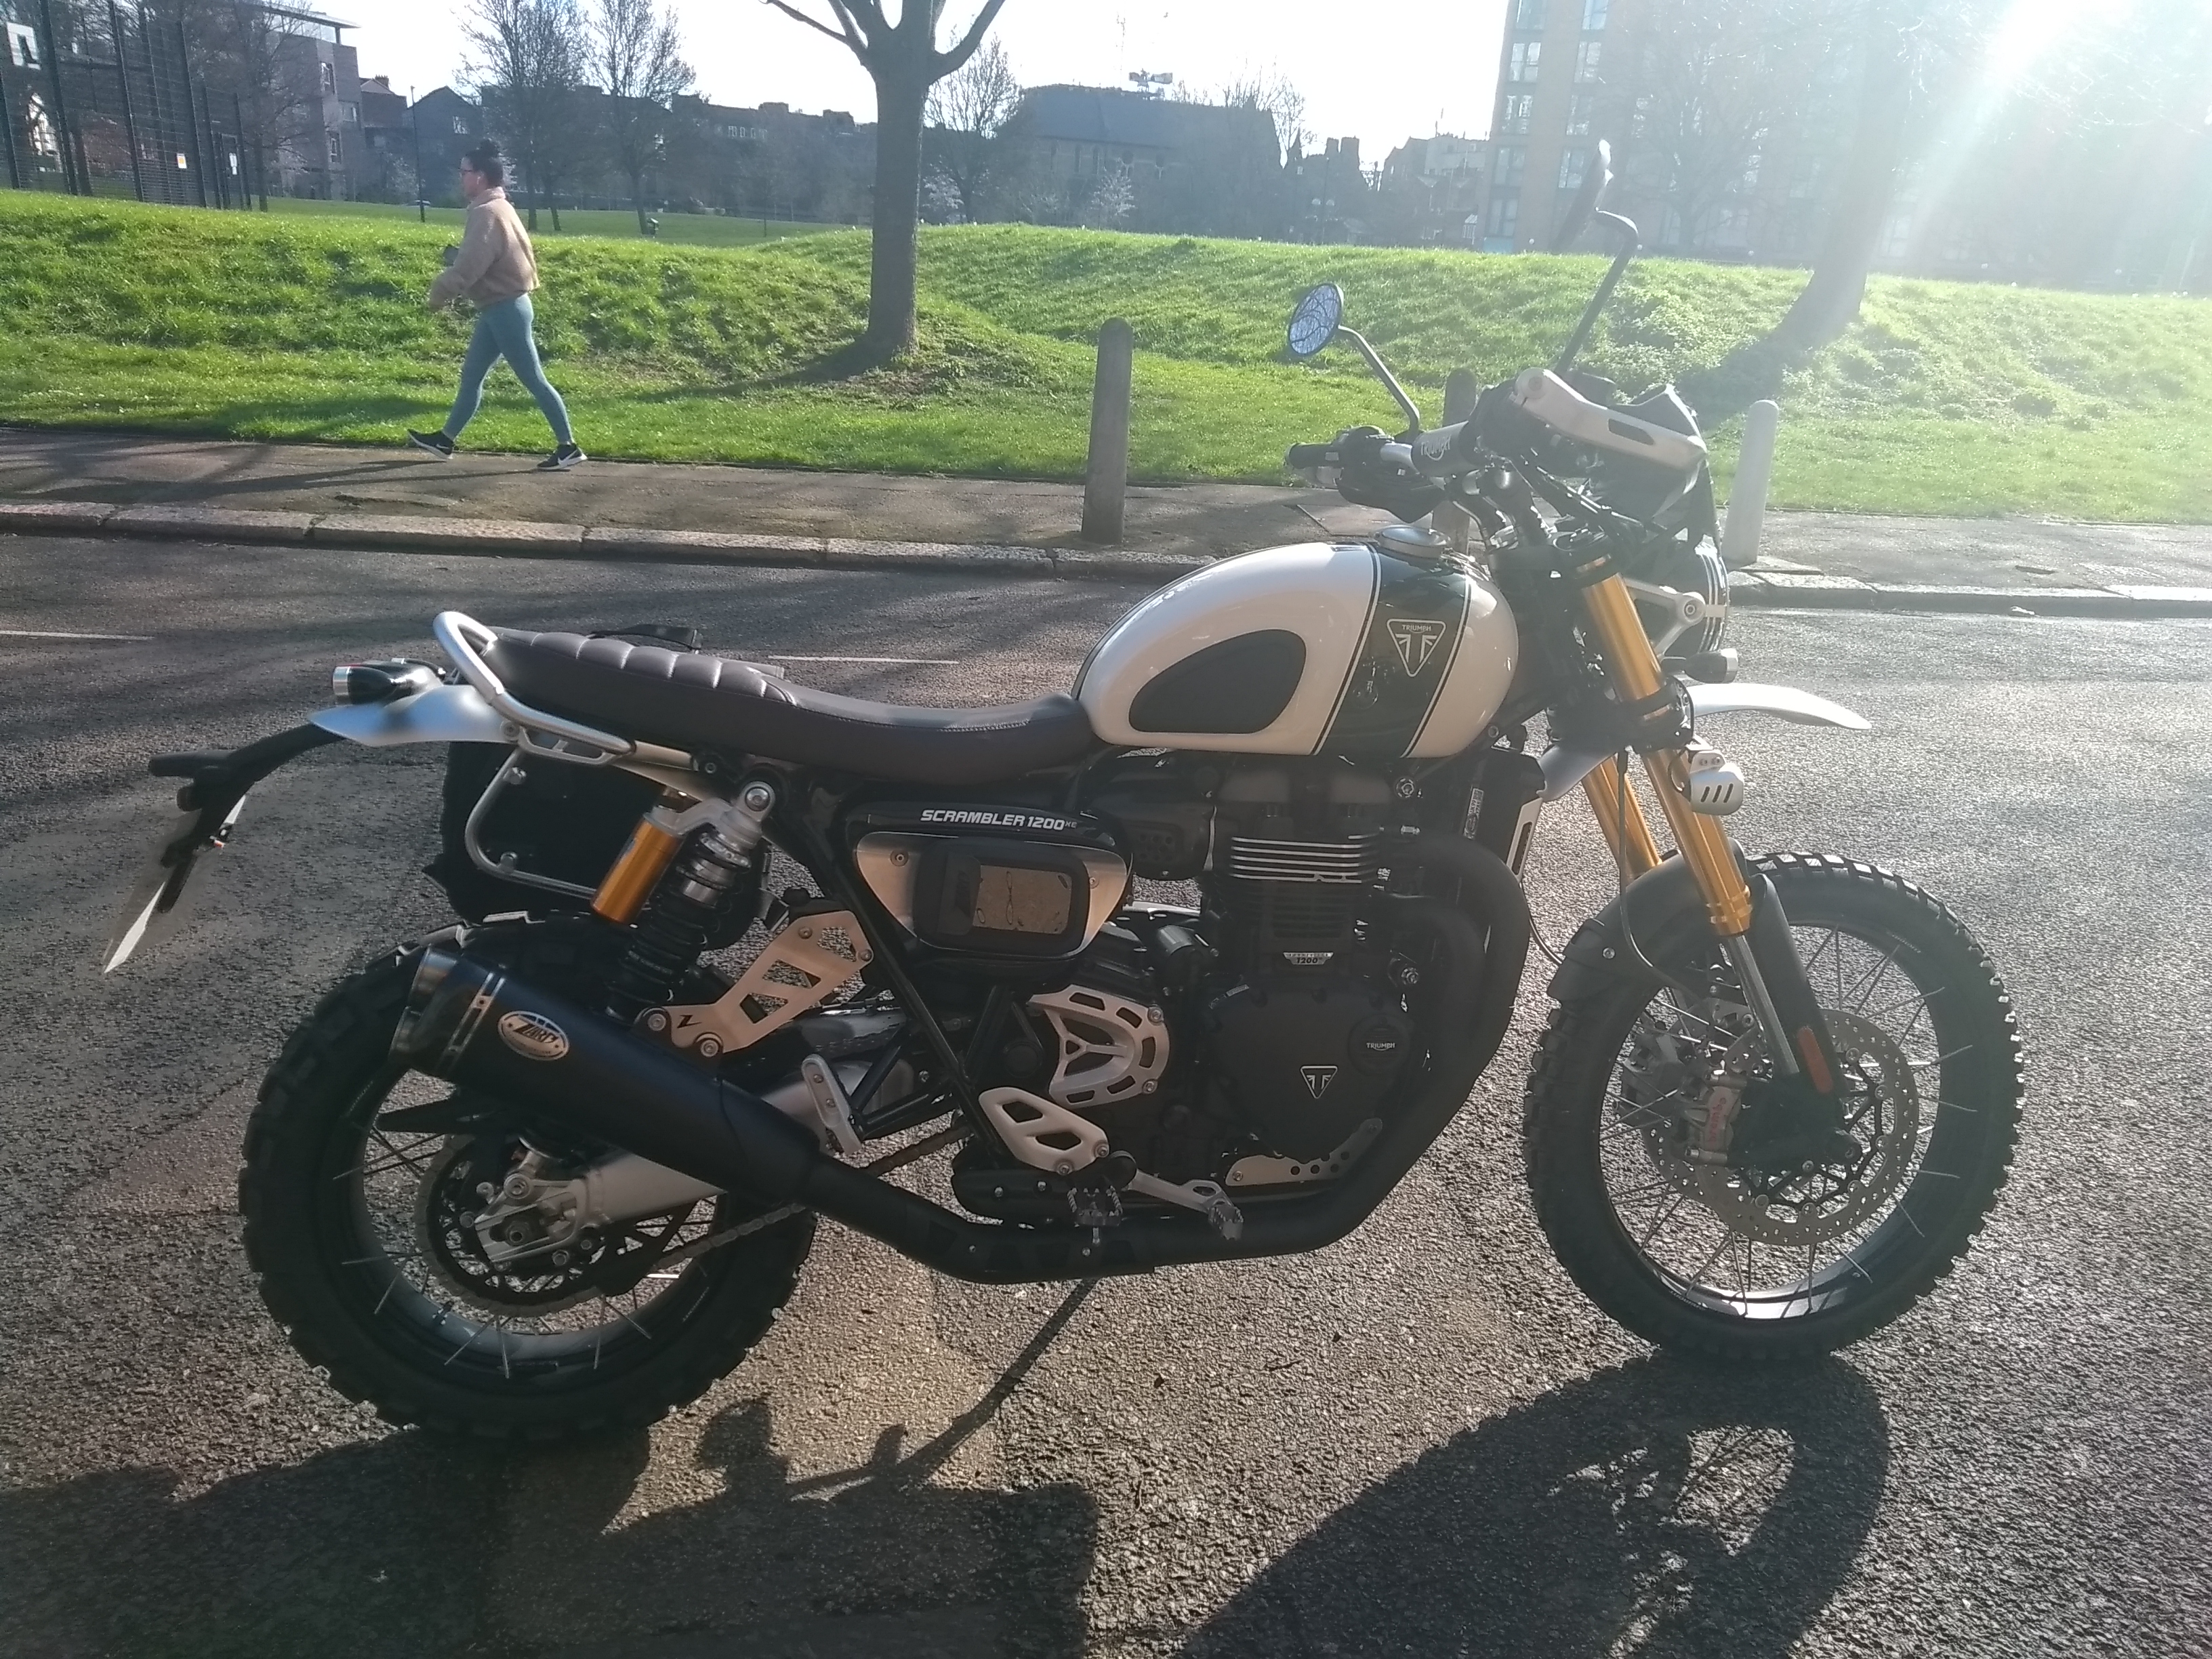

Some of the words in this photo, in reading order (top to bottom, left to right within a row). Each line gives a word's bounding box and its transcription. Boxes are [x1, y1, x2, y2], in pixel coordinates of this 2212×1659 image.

[1402, 624, 1431, 633] TRIUMPH
[920, 809, 1025, 827] SCRAMBLER
[1027, 816, 1065, 831] 1200
[1366, 1042, 1395, 1050] TRIUMPH
